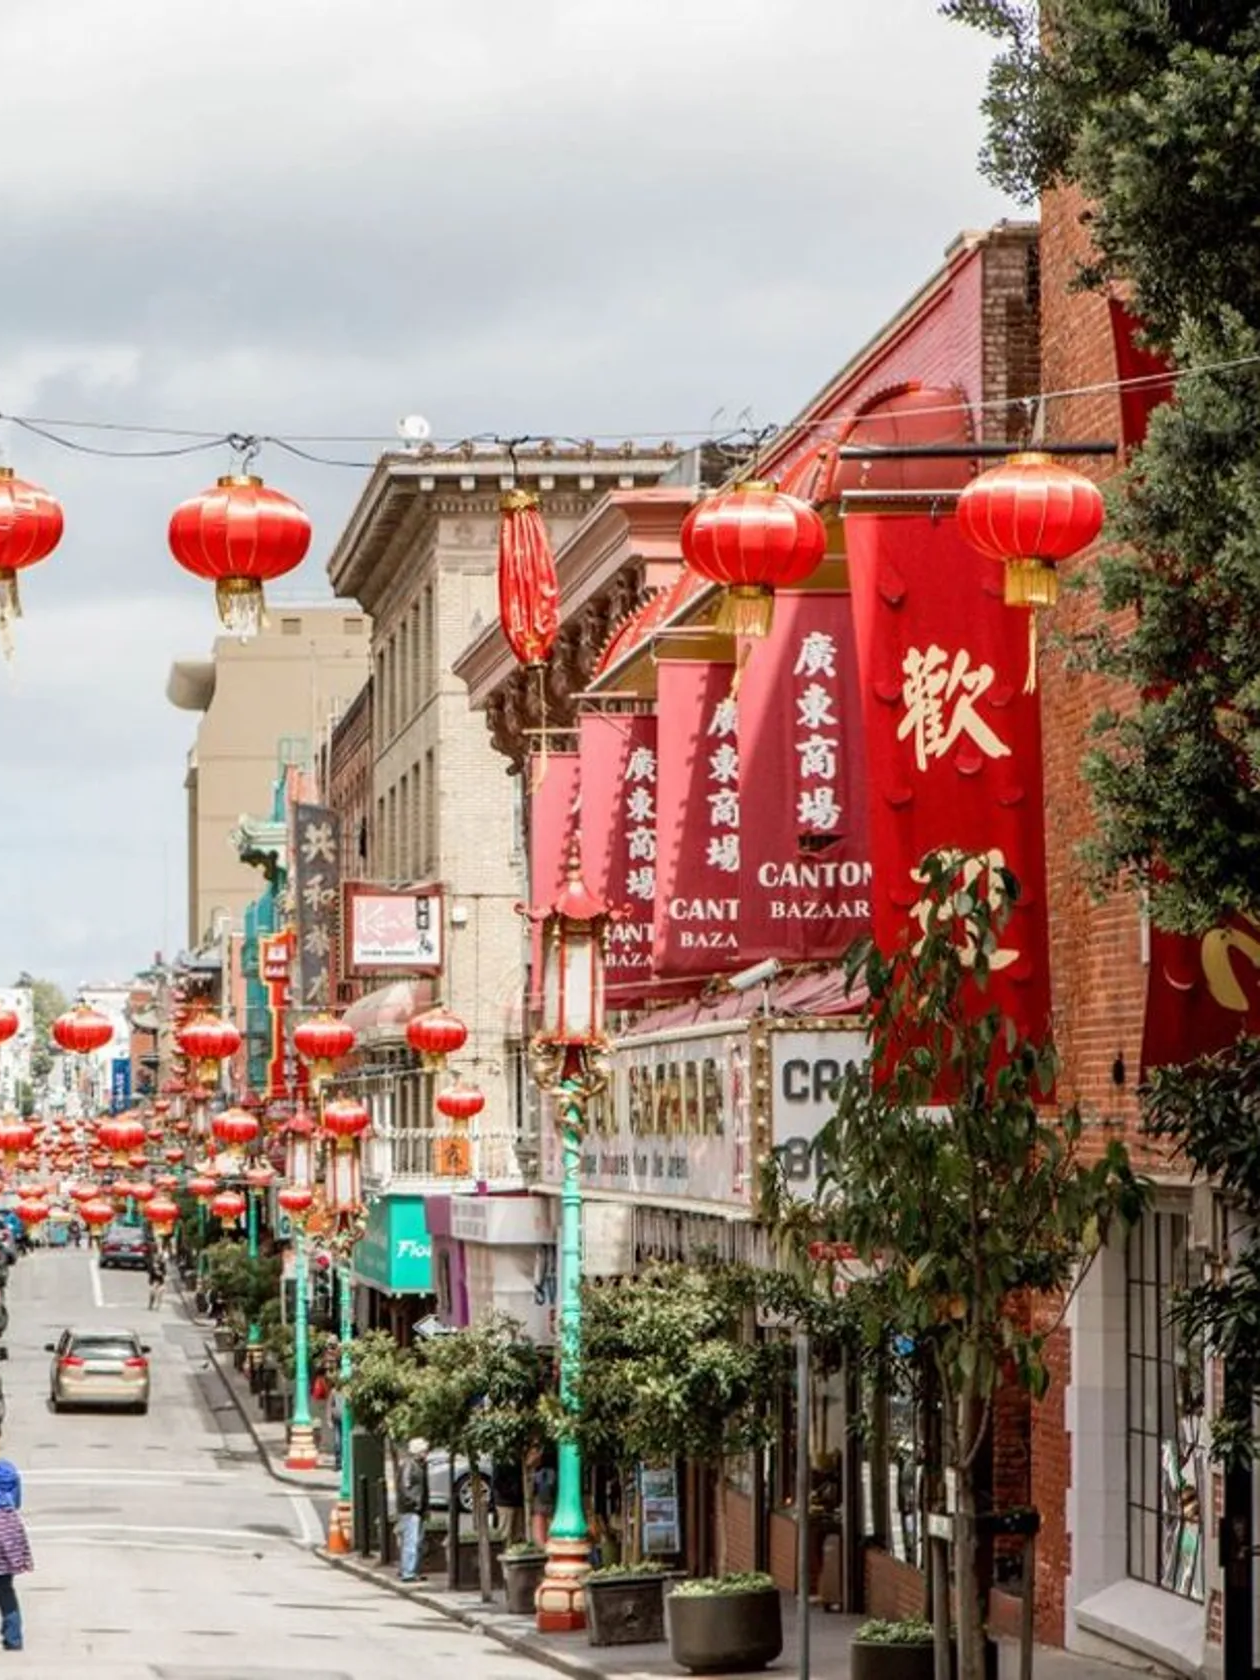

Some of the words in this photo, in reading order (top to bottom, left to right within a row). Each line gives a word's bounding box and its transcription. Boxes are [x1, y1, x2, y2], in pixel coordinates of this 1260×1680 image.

[793, 631, 842, 830] 廣東商場
[669, 898, 740, 921] CANT
[770, 900, 871, 919] BAZAAR
[680, 931, 738, 949] BAZA
[605, 952, 654, 969] BAZA
